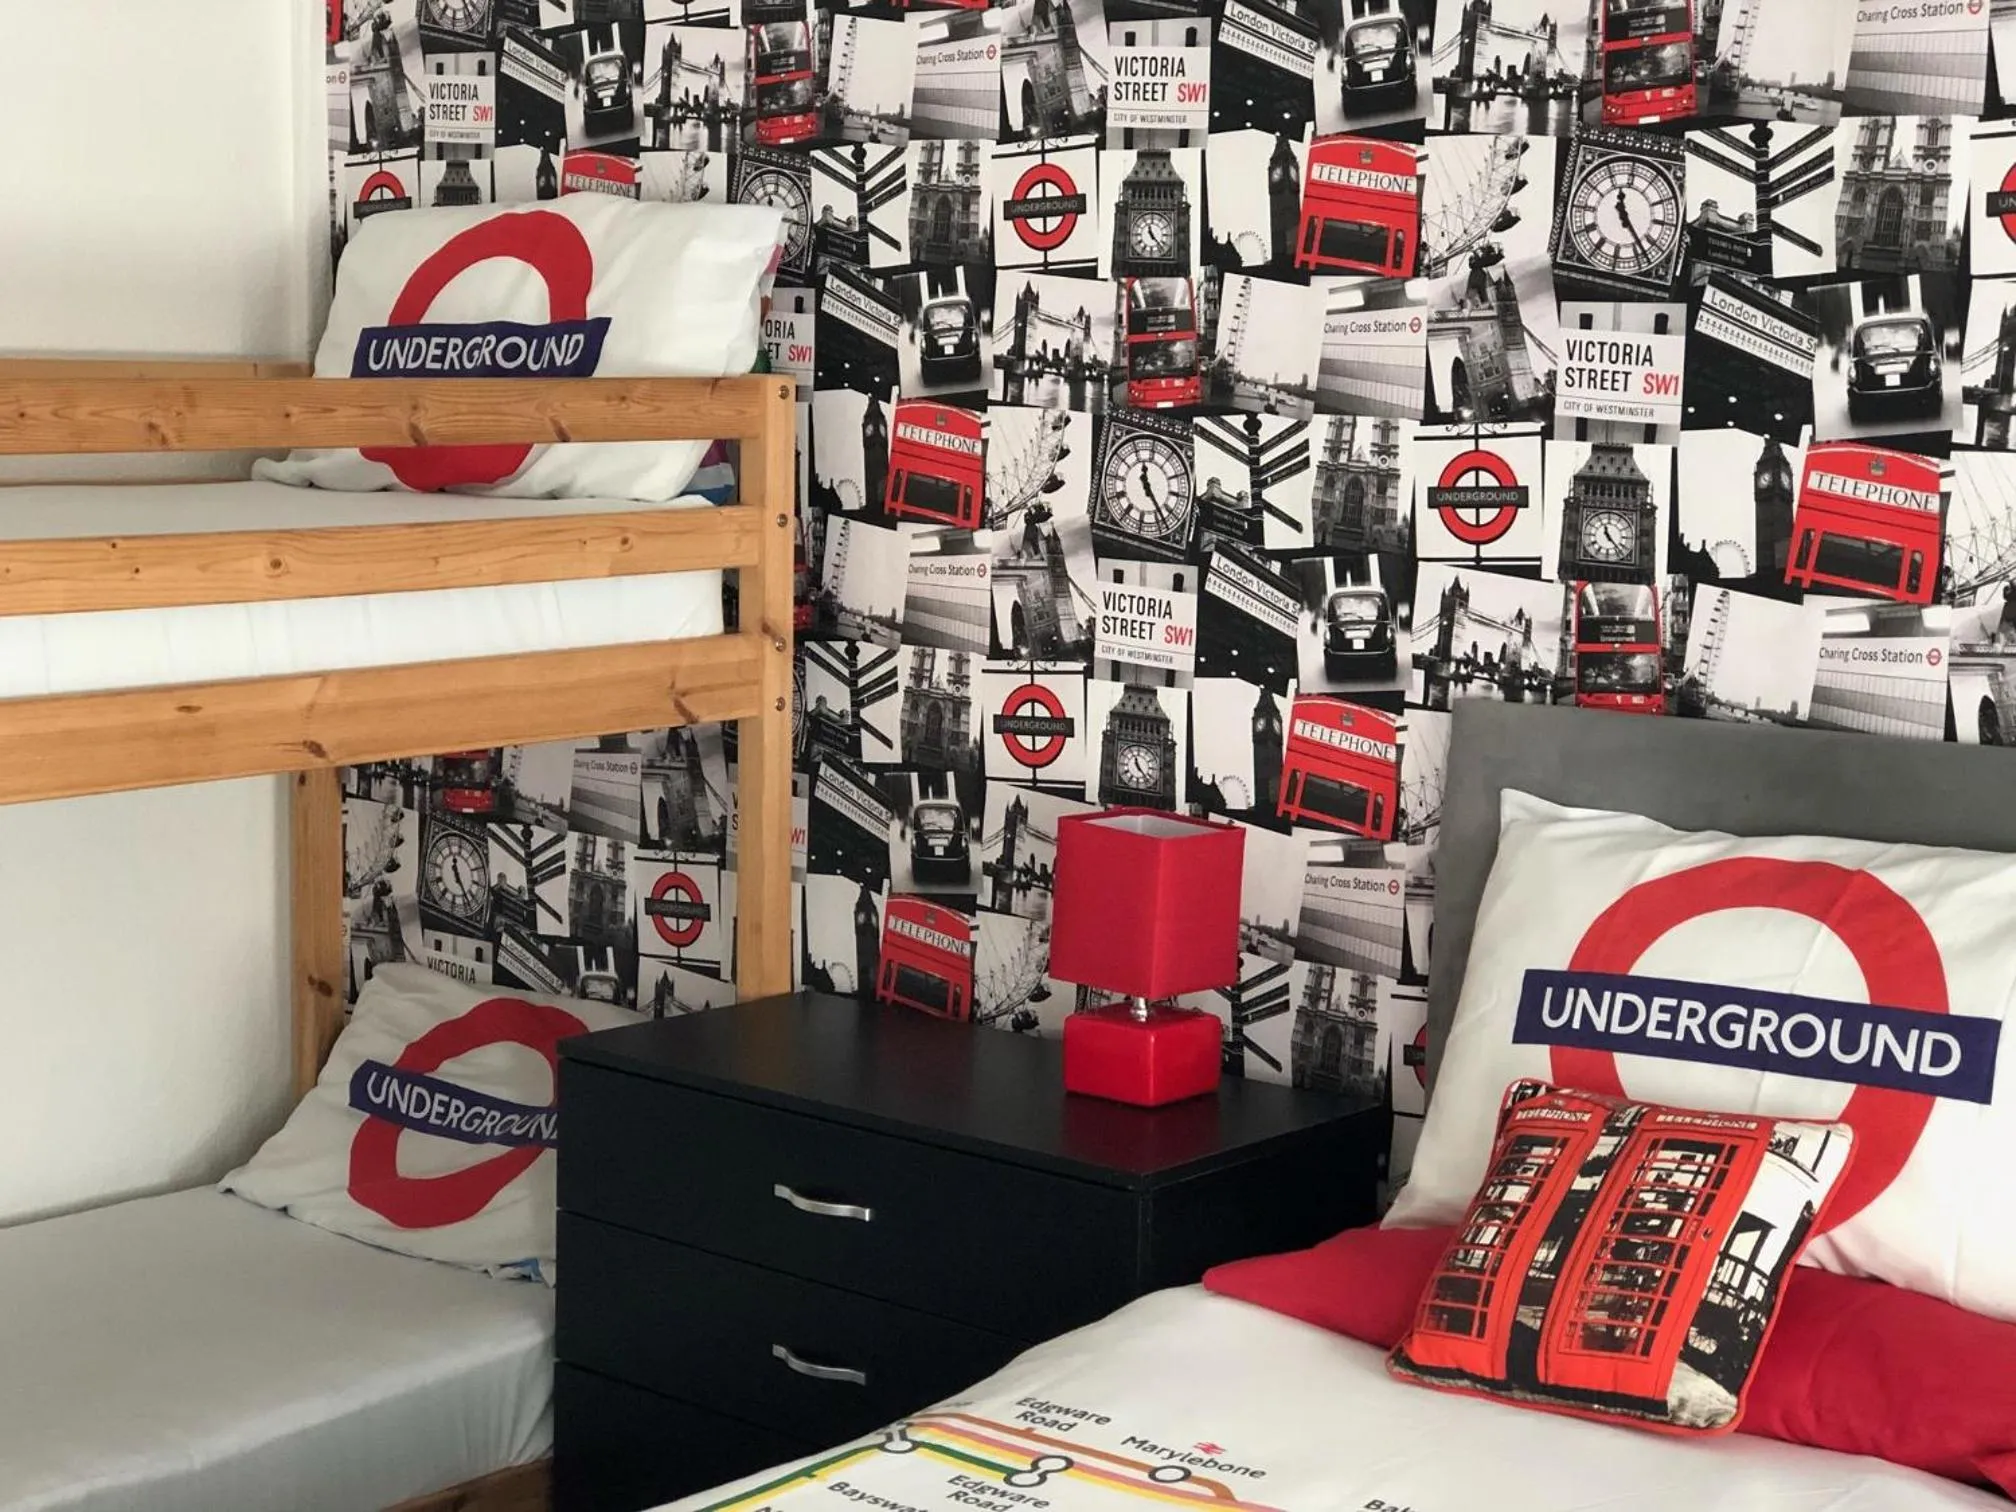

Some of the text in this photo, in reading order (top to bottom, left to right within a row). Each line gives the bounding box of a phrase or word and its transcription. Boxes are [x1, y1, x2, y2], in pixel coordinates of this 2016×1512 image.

[1230, 4, 1269, 33] London
[1271, 23, 1305, 49] Victoria
[1857, 3, 1963, 23] Charing Cross Station
[957, 49, 984, 61] Station
[1114, 56, 1185, 77] VICTORIA
[429, 82, 479, 100] VICTORIA
[1114, 82, 1207, 103] STREET SW1
[430, 104, 493, 121] STREET SW1
[569, 175, 633, 198] TELEPHONE
[1317, 165, 1414, 193] TELEPHONE
[830, 278, 861, 303] London
[1324, 321, 1406, 336] Charing Cross Station
[1711, 291, 1757, 323] London
[1762, 314, 1803, 346] Victoria
[368, 333, 585, 372] UNDERGROUND
[1566, 339, 1653, 367] VICTORIA
[1565, 367, 1679, 396] STREET SW1
[1564, 401, 1654, 417] CITY OF WESTMINSTER
[902, 424, 978, 453] TELEPHONE
[1437, 491, 1519, 501] UNDERGROUND
[1816, 473, 1936, 511] TELEPHONE
[949, 564, 975, 576] Station
[1217, 556, 1254, 589] London
[1257, 580, 1290, 609] Victoria
[1103, 591, 1172, 620] VICTORIA
[1102, 615, 1193, 646] STREET SW1
[1819, 647, 1923, 663] Charing Cross Station
[1300, 721, 1393, 760] TELEPHONE
[824, 767, 855, 796] London
[1330, 875, 1350, 889] Cross
[1352, 877, 1385, 892] Station
[893, 918, 968, 953] TELEPHONE
[427, 956, 476, 984] VICTORIA
[1541, 987, 1961, 1077] UNDERGROUND
[367, 1071, 558, 1140] UNDERGROUN
[1015, 1397, 1111, 1425] Edgware
[1015, 1411, 1078, 1432] Road
[1120, 1435, 1267, 1479] Marylebone
[946, 1490, 1014, 1512] Road
[947, 1474, 1050, 1508] Edgware
